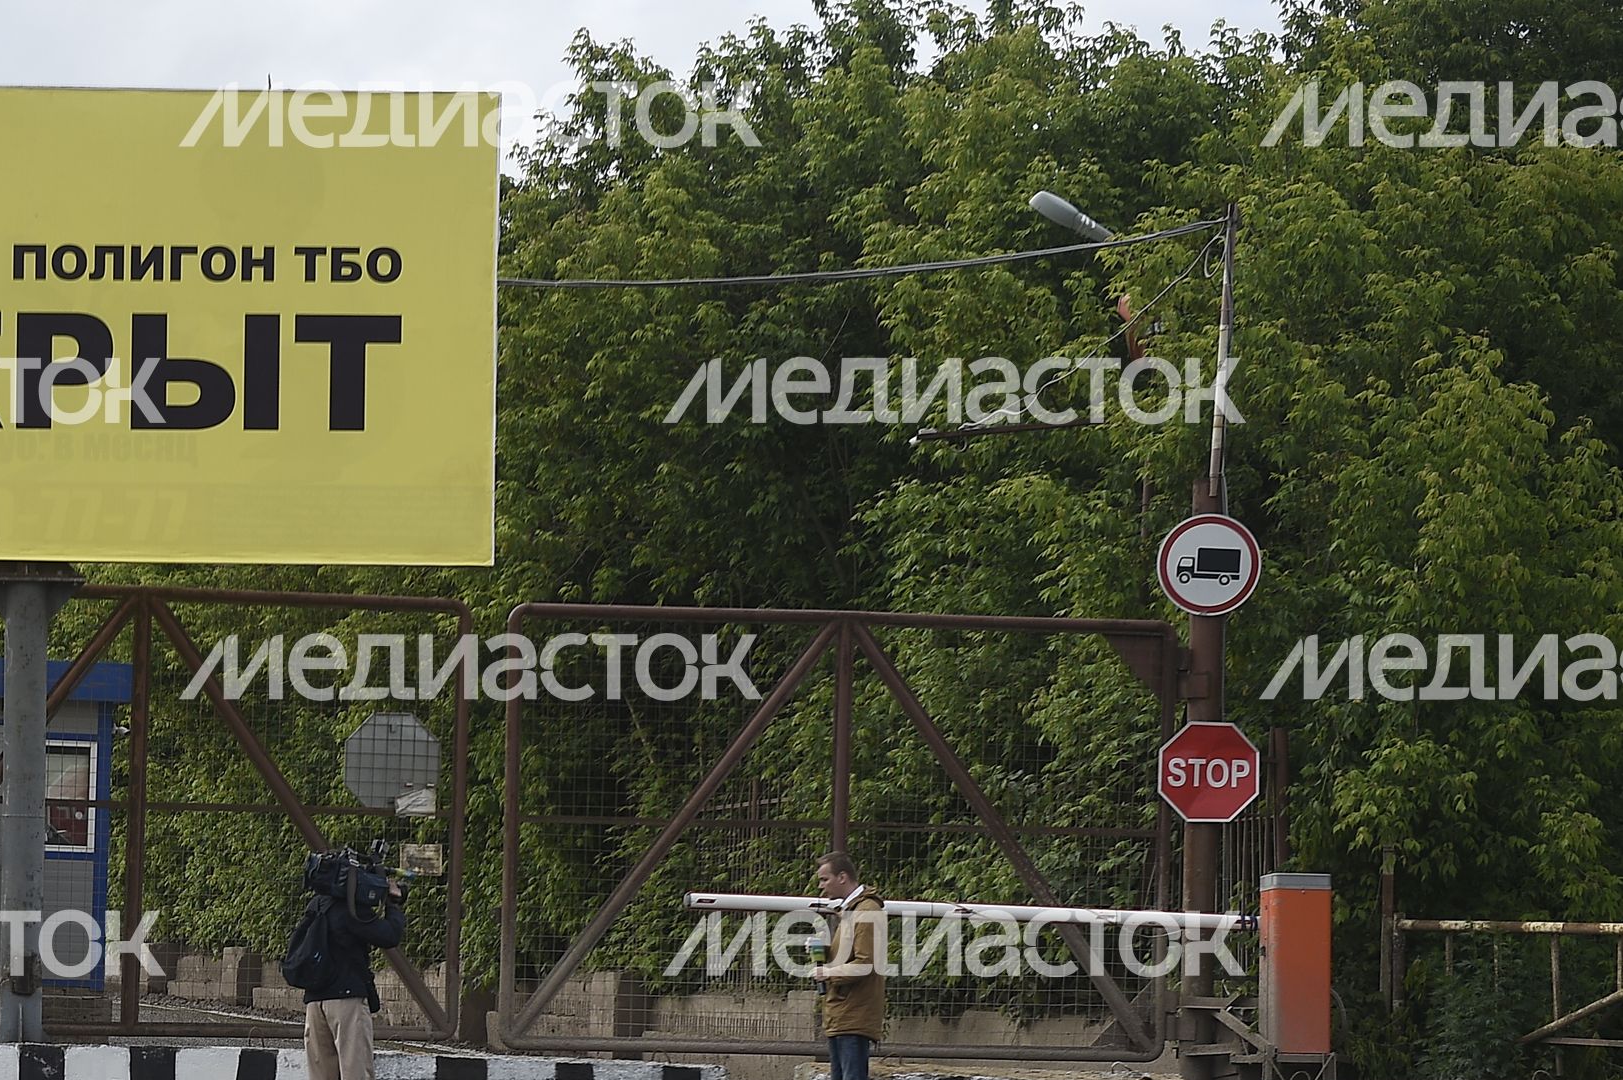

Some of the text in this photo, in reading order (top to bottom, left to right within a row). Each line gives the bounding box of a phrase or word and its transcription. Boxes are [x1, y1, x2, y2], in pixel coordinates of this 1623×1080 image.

[12, 243, 276, 282] ПОЛИГОН
[294, 246, 402, 283] ТБО
[1167, 758, 1250, 788] STOP
